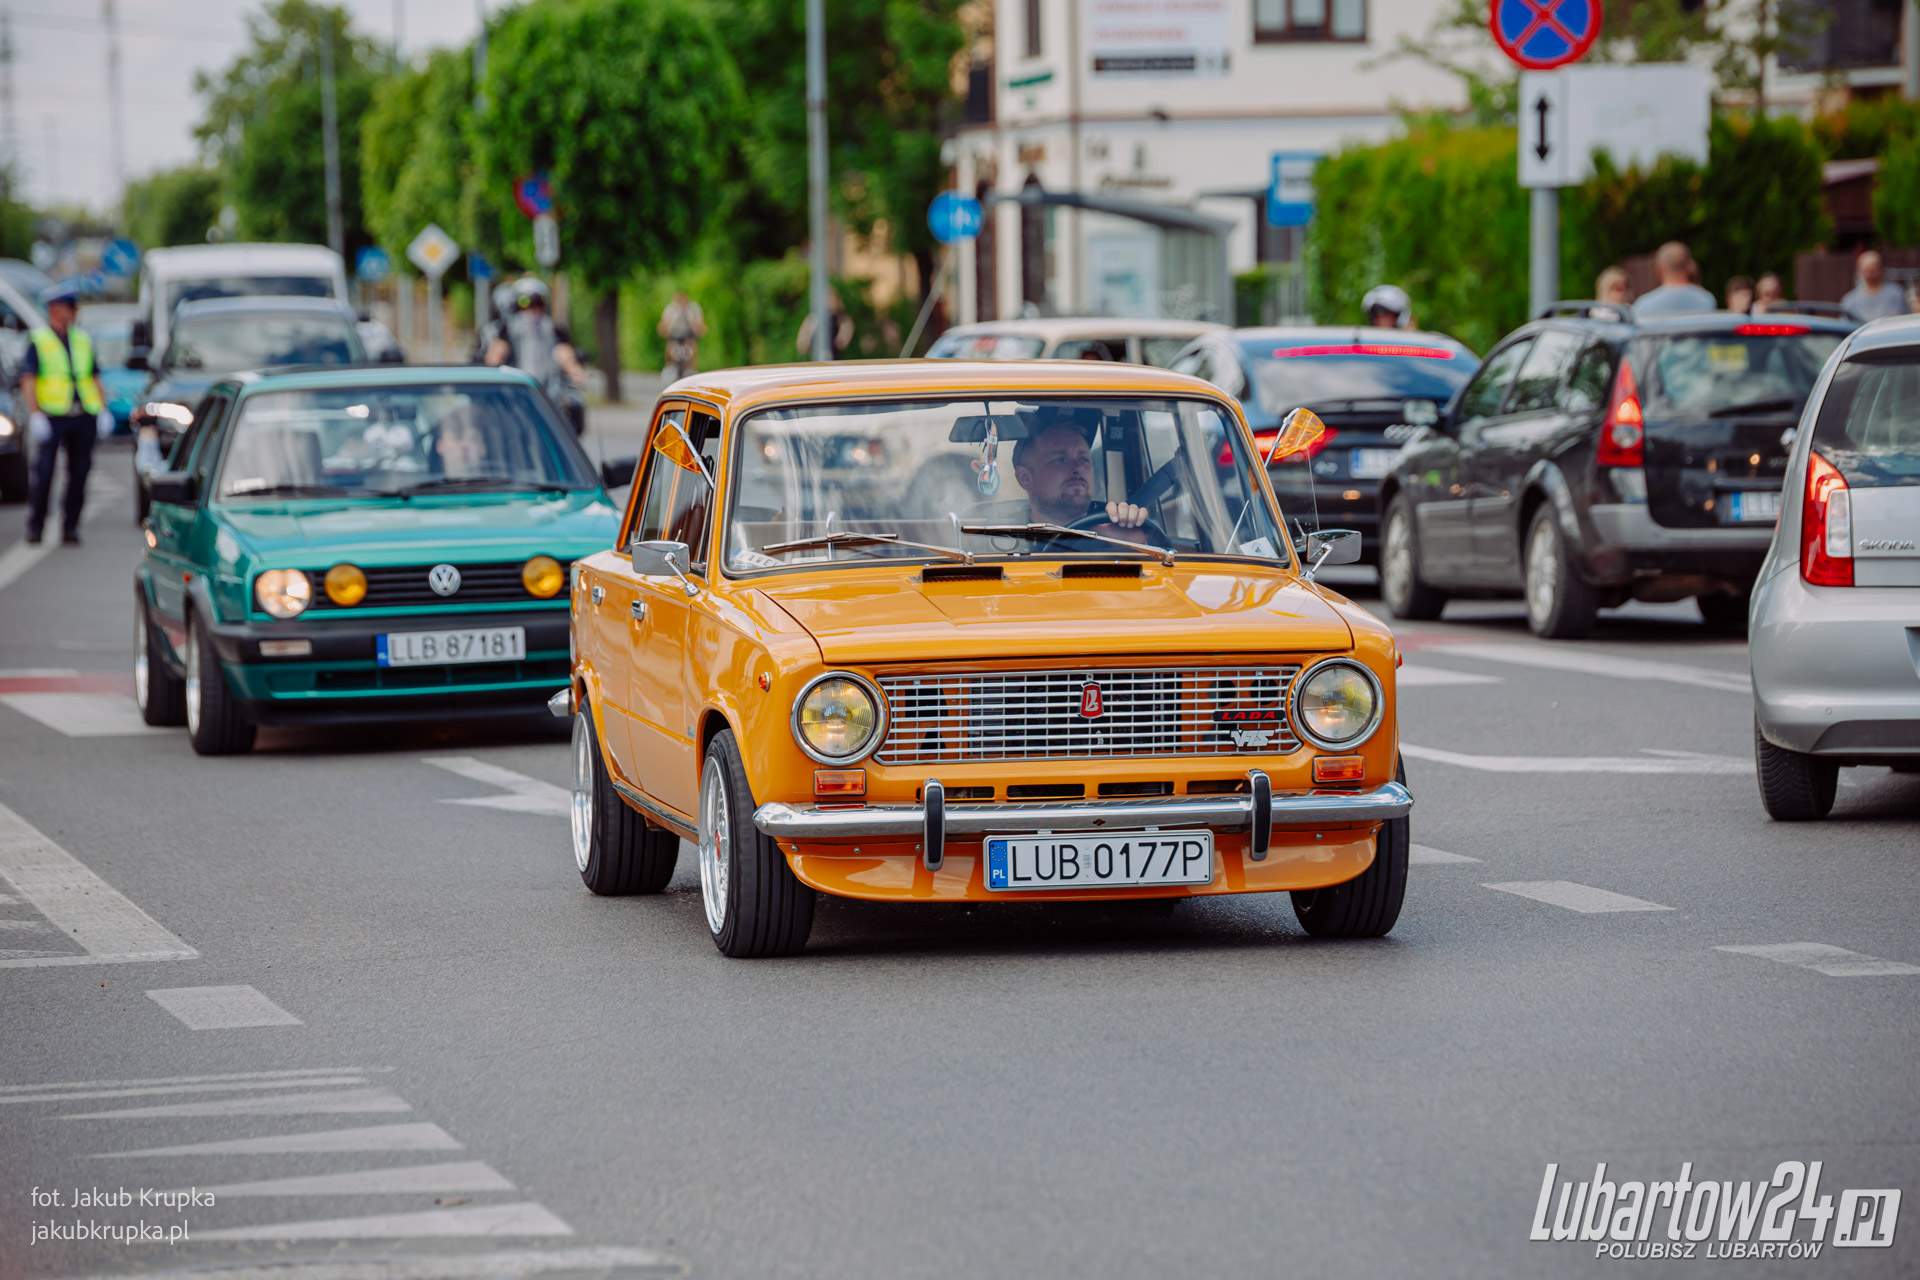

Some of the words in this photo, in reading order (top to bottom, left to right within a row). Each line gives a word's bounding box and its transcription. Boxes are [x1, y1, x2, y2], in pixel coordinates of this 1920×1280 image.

[390, 635, 438, 661] LLB
[446, 631, 518, 657] 87181
[1221, 711, 1276, 720] LADA
[1012, 843, 1080, 882] LUB
[1094, 840, 1204, 879] 0177P
[992, 869, 1007, 880] PL
